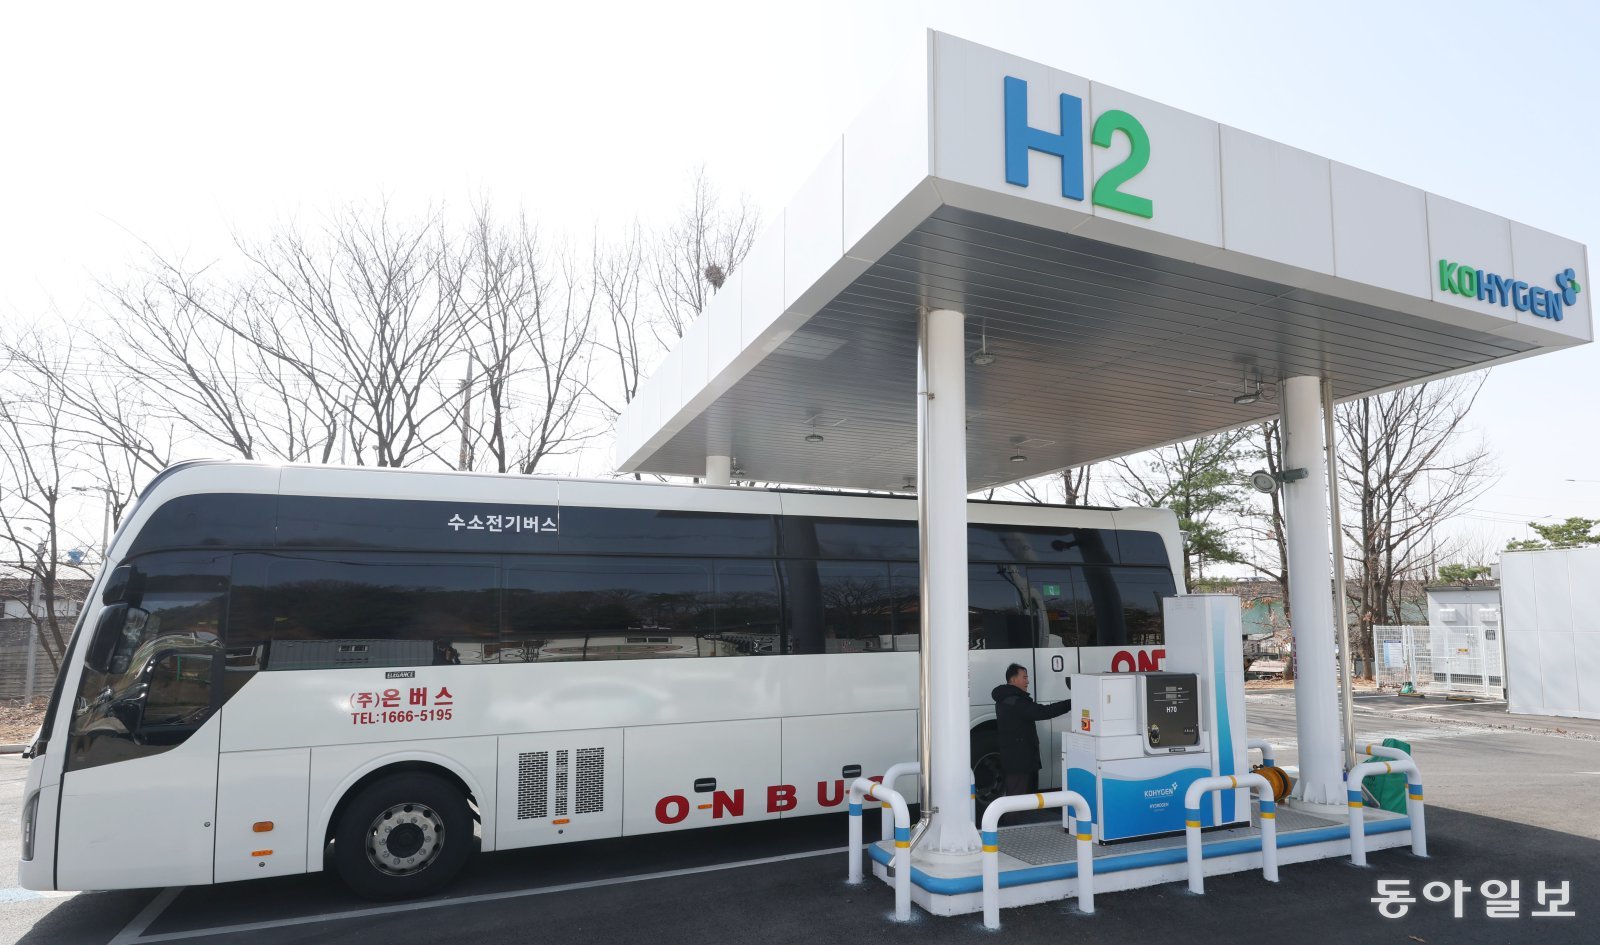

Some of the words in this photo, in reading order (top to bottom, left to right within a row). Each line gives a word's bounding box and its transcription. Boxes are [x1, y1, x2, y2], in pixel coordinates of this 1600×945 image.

[1004, 75, 1153, 219] H2
[1439, 259, 1563, 321] KOHYGEN
[447, 513, 558, 533] 수소전기버스
[351, 708, 453, 724] TEL:1666-5195
[1144, 788, 1174, 797] KOHYGEN
